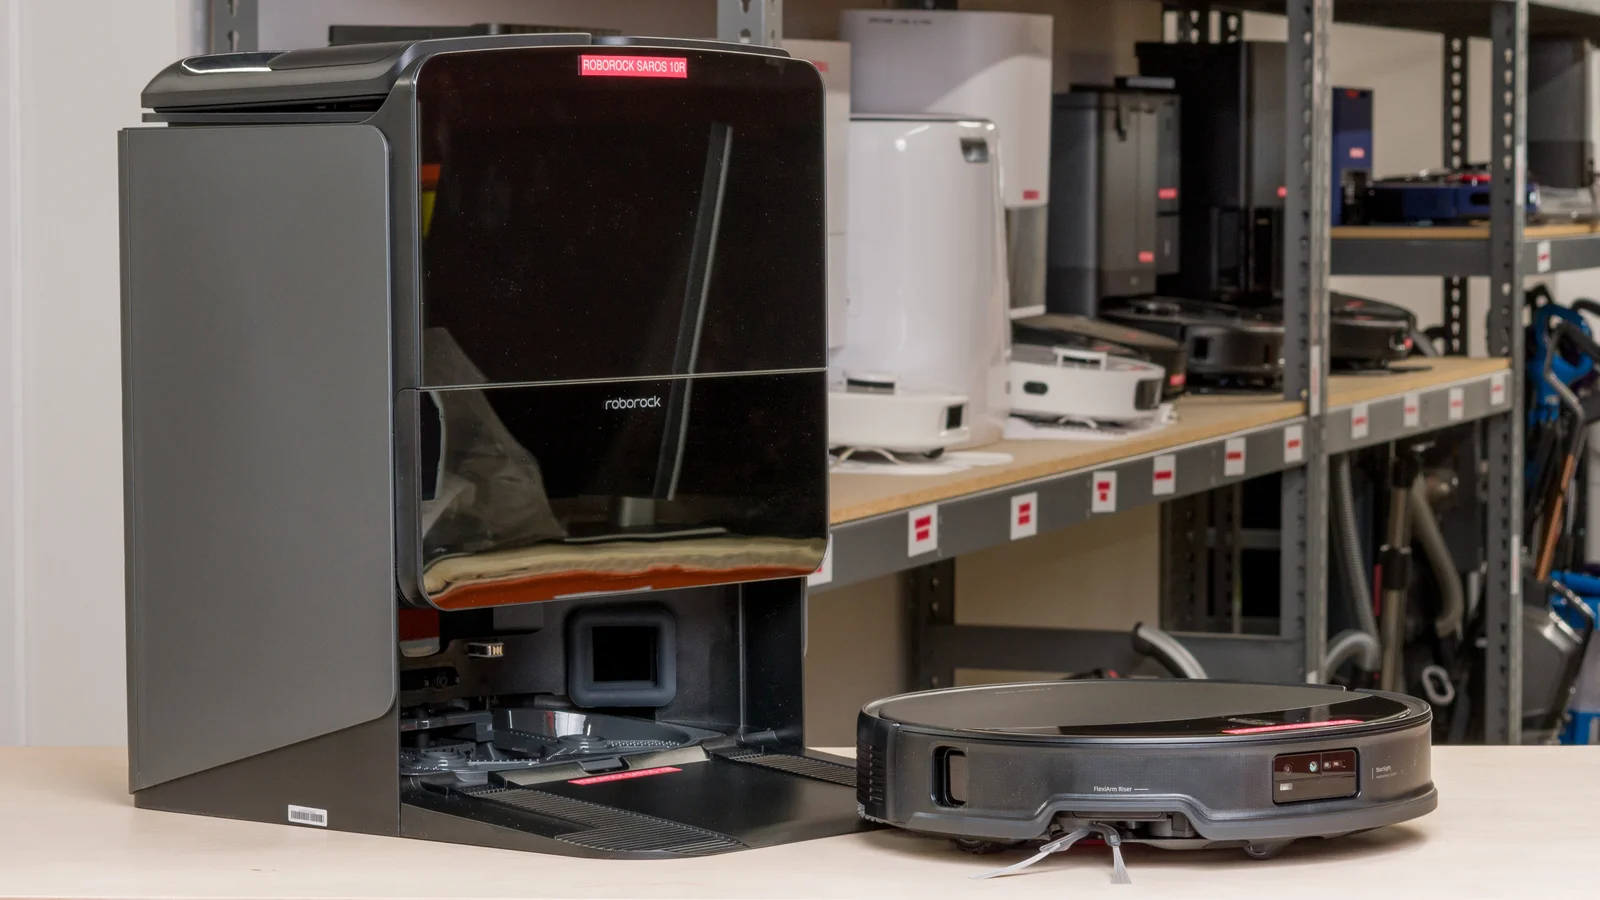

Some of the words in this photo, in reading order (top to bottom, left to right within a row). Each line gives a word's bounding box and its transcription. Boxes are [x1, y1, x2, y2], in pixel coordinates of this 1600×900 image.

[583, 59, 635, 71] ROBOROCK
[636, 60, 668, 73] SAROS
[669, 61, 686, 73] 10R
[605, 395, 661, 410] roborock
